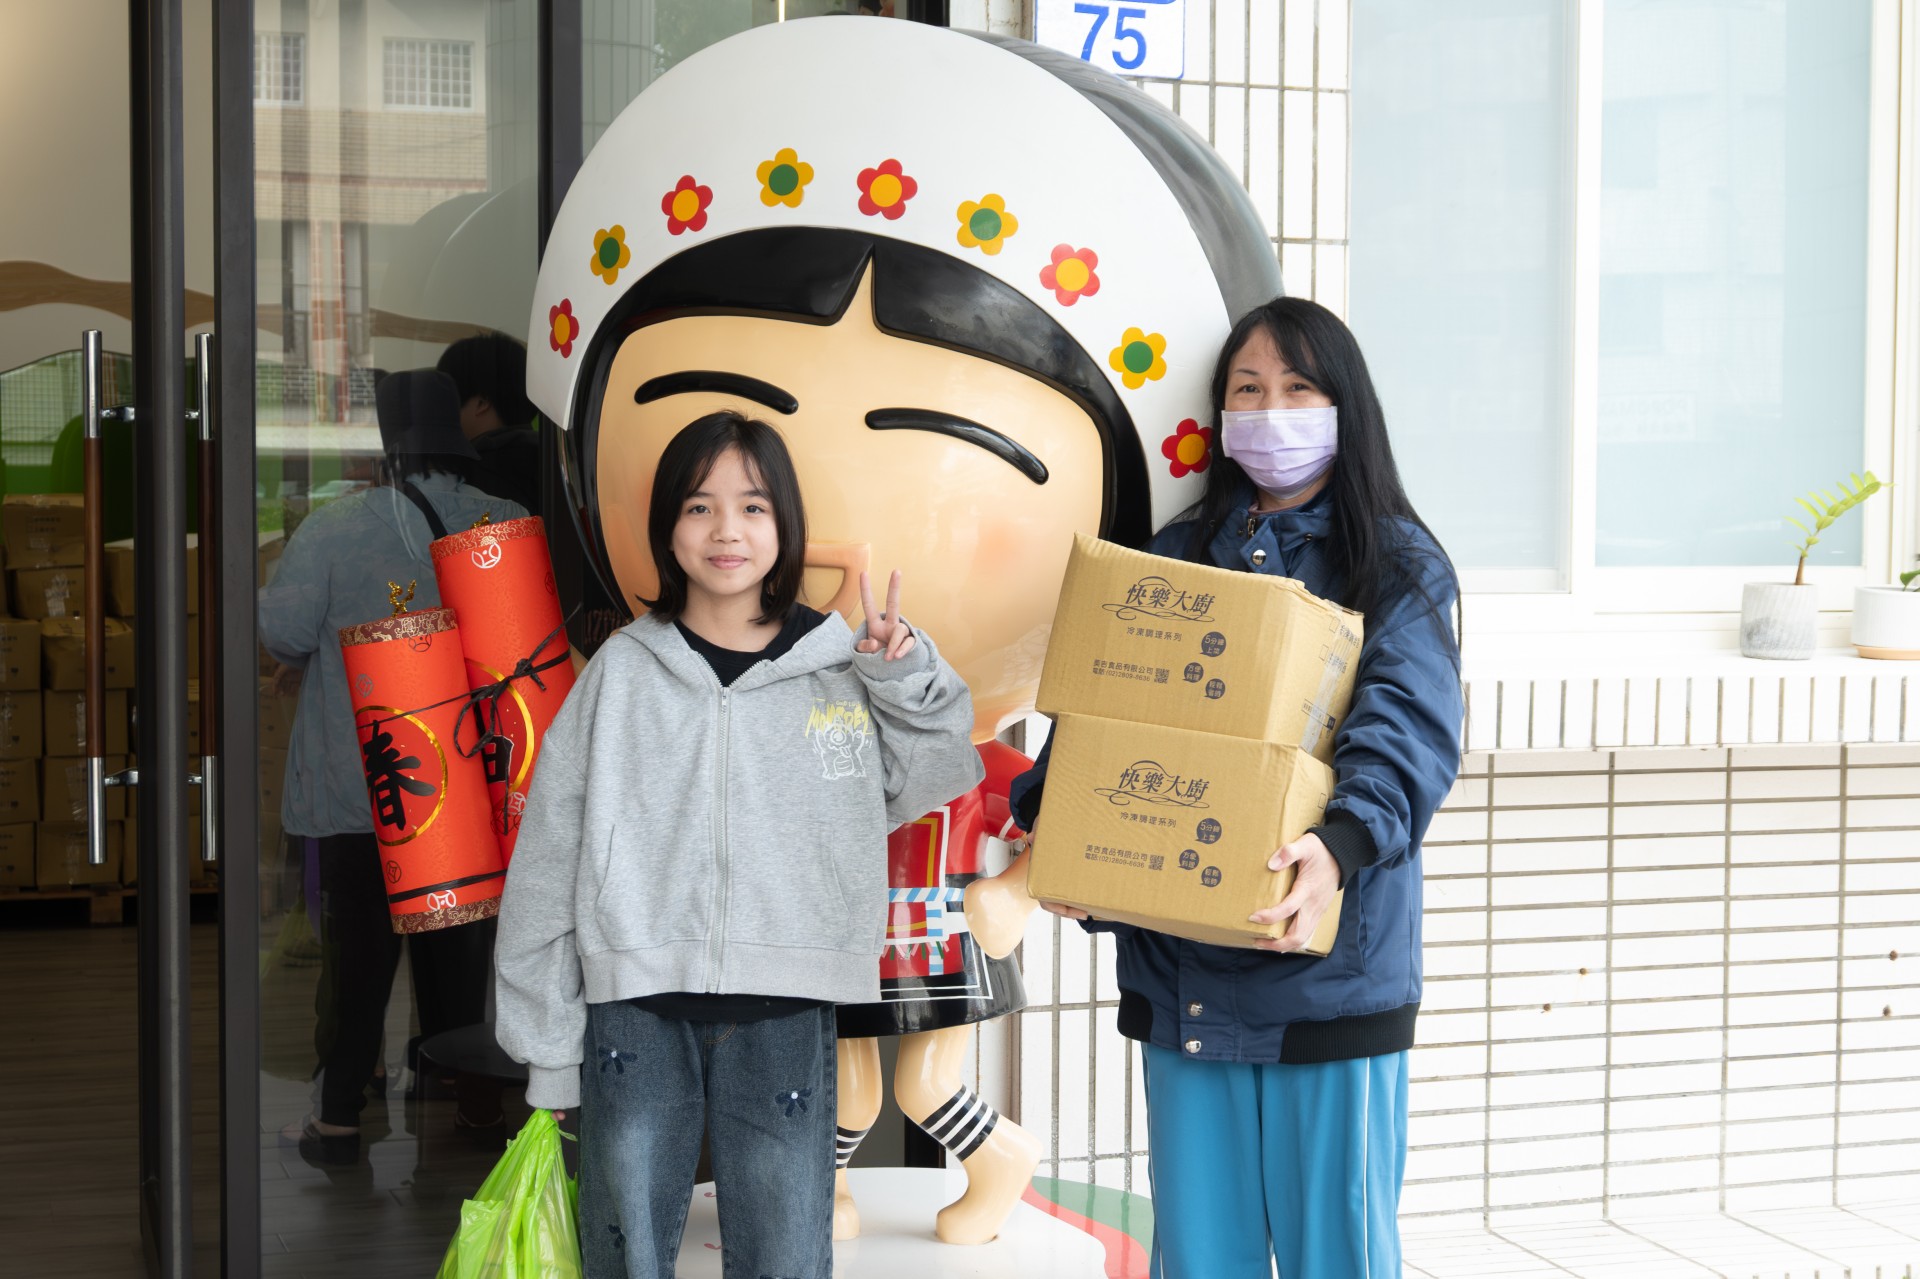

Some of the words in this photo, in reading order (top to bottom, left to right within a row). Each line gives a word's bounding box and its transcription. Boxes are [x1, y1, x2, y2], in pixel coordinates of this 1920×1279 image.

[1074, 3, 1147, 70] 75
[1125, 583, 1216, 614] 快樂大廚
[1126, 626, 1183, 642] 冷凍調理系列
[363, 719, 436, 831] 春
[1118, 768, 1210, 801] 快樂大廚
[1120, 811, 1177, 828] 冷凍調理系列
